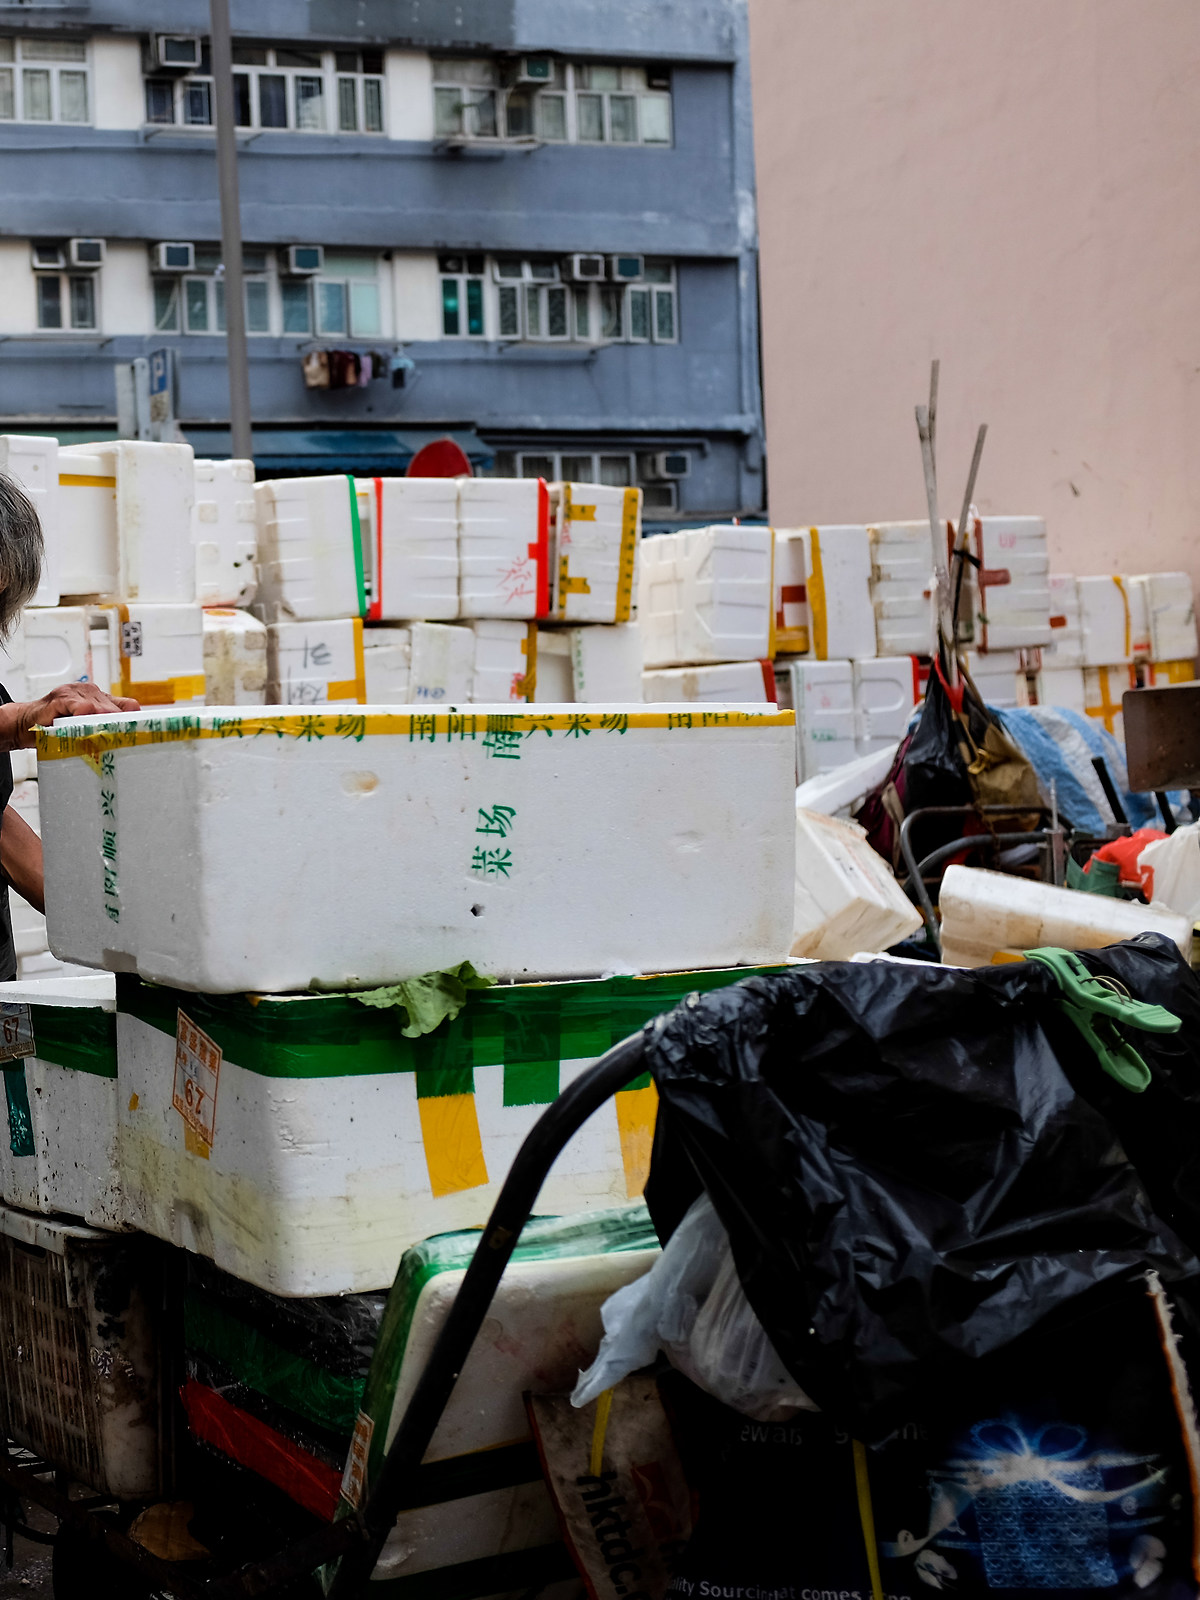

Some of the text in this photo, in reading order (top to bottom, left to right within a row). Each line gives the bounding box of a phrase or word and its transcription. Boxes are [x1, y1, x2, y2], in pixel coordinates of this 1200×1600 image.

[153, 355, 164, 391] P
[2, 1017, 20, 1044] 67
[184, 1078, 205, 1115] 67
